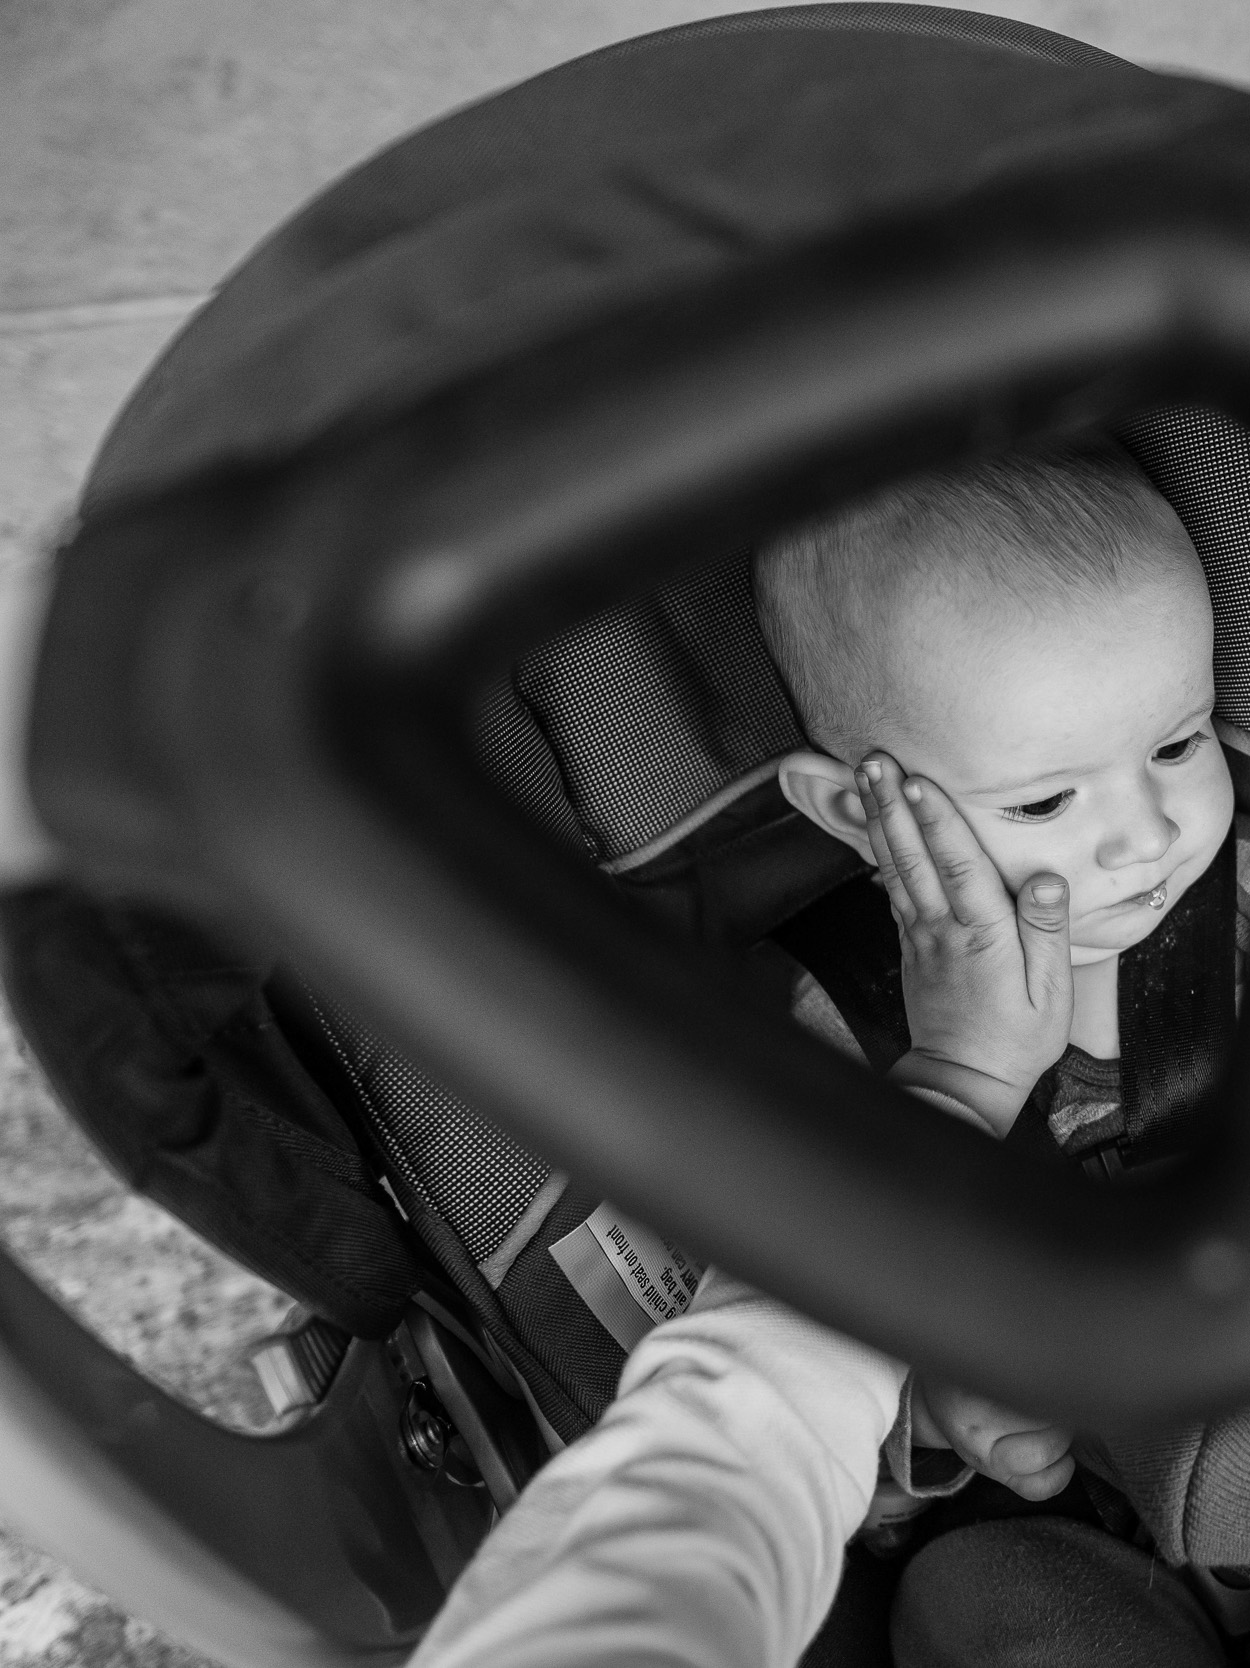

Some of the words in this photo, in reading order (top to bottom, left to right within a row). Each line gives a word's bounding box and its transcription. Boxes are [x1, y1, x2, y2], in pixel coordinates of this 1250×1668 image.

[606, 1224, 630, 1255] front
[623, 1249, 638, 1267] on
[671, 1248, 686, 1270] can
[630, 1262, 650, 1289] seat
[660, 1266, 677, 1295] bag.
[642, 1285, 668, 1312] child
[673, 1289, 687, 1306] air
